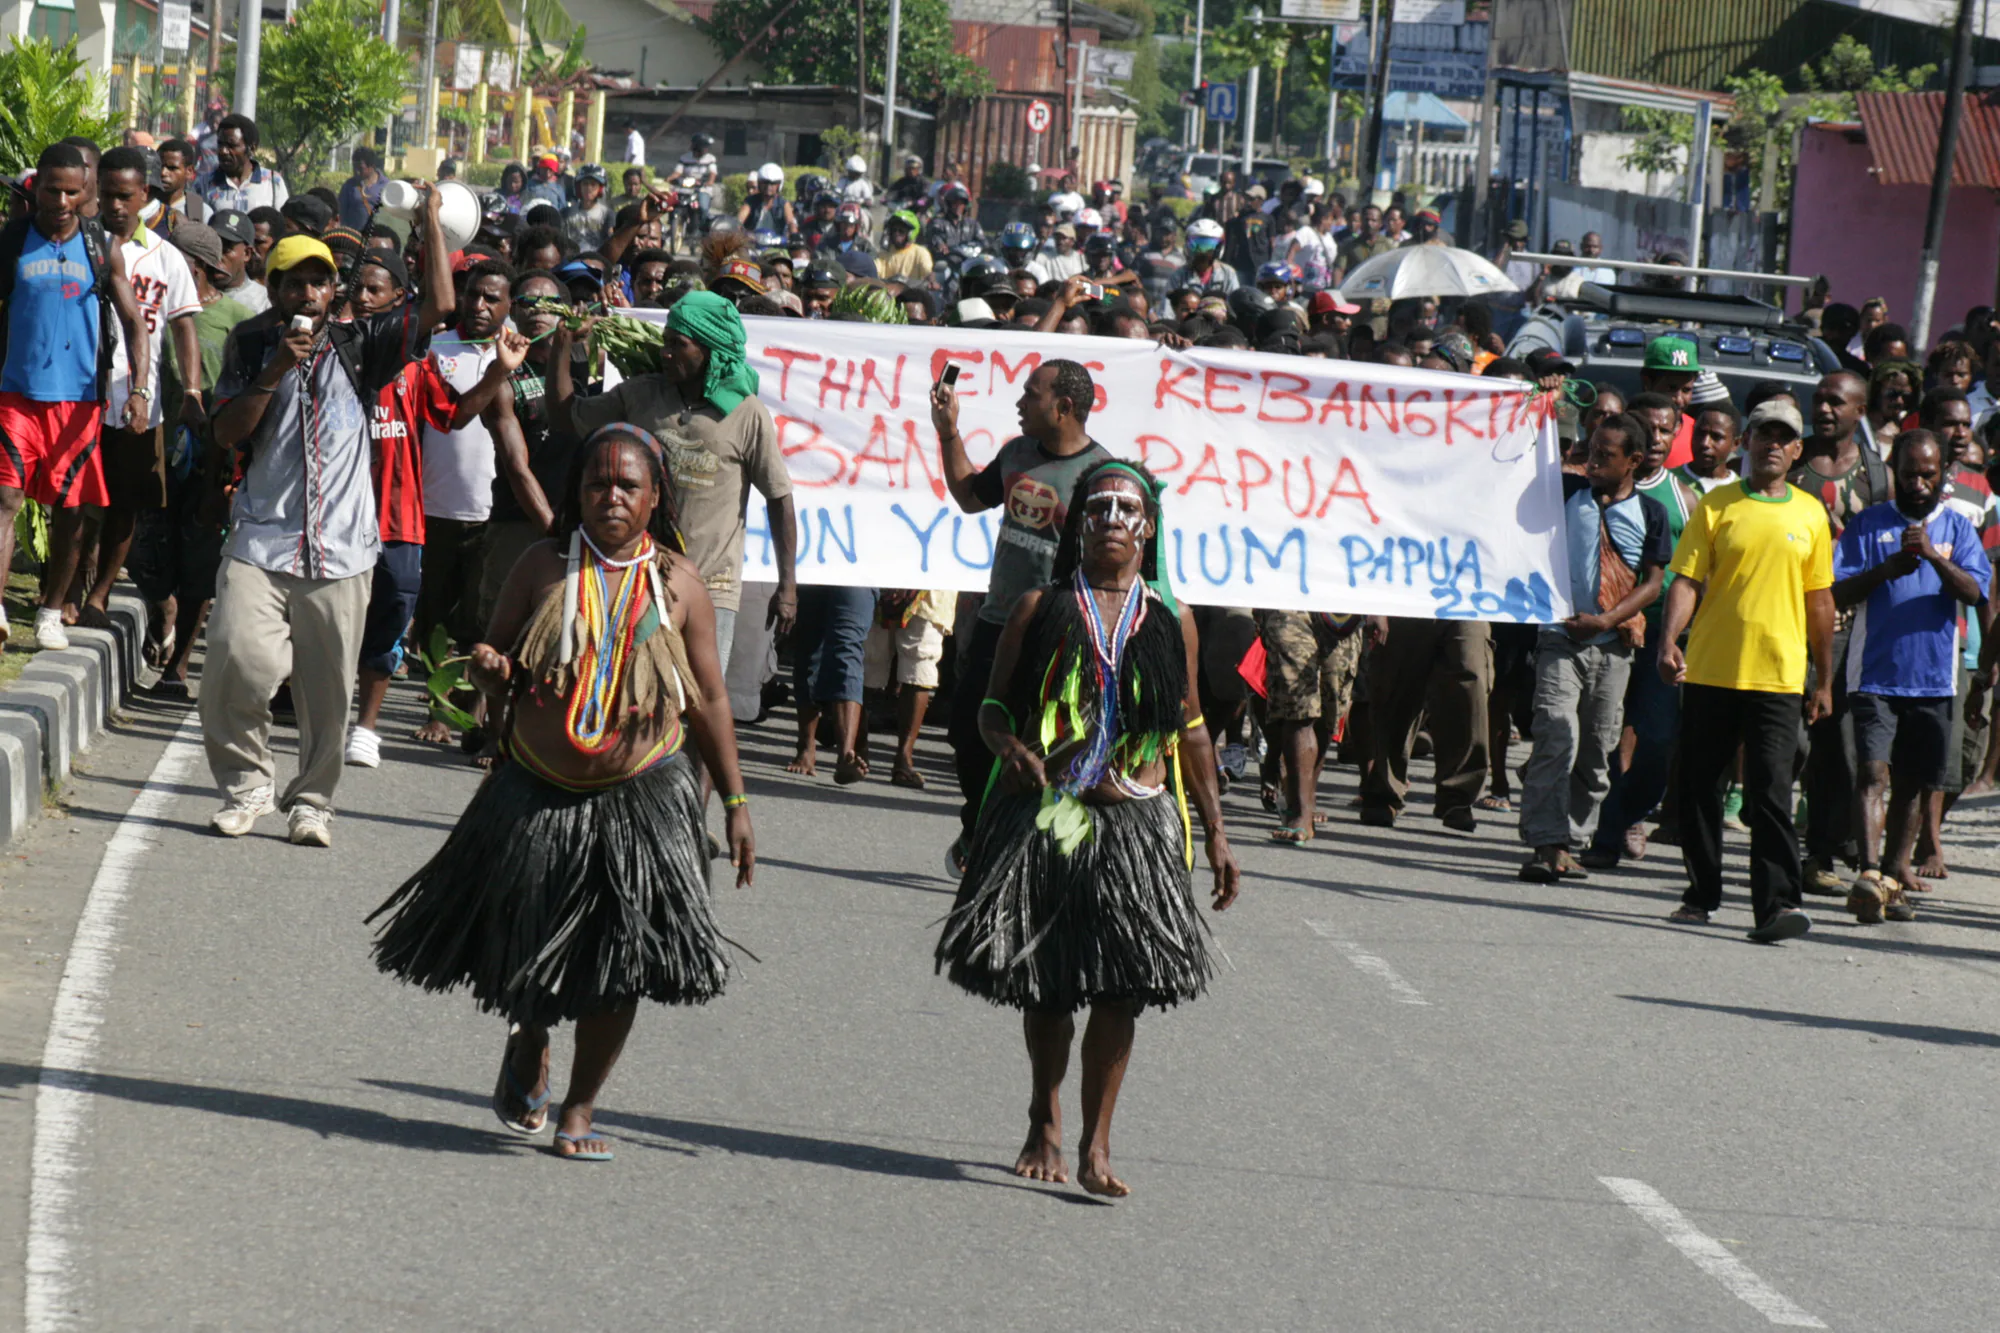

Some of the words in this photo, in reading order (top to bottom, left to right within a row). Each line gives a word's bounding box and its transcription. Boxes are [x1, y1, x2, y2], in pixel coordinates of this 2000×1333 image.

[61, 281, 81, 299] 23
[370, 418, 408, 440] irates
[763, 346, 907, 410] THN
[931, 348, 1108, 413] EMS
[1155, 358, 1557, 446] KEBANGKITA
[774, 414, 1021, 502] BAN
[1135, 434, 1381, 525] PAPUA
[743, 503, 858, 567] HUN
[1339, 535, 1482, 590] PAPUA
[1429, 570, 1554, 624] 20
